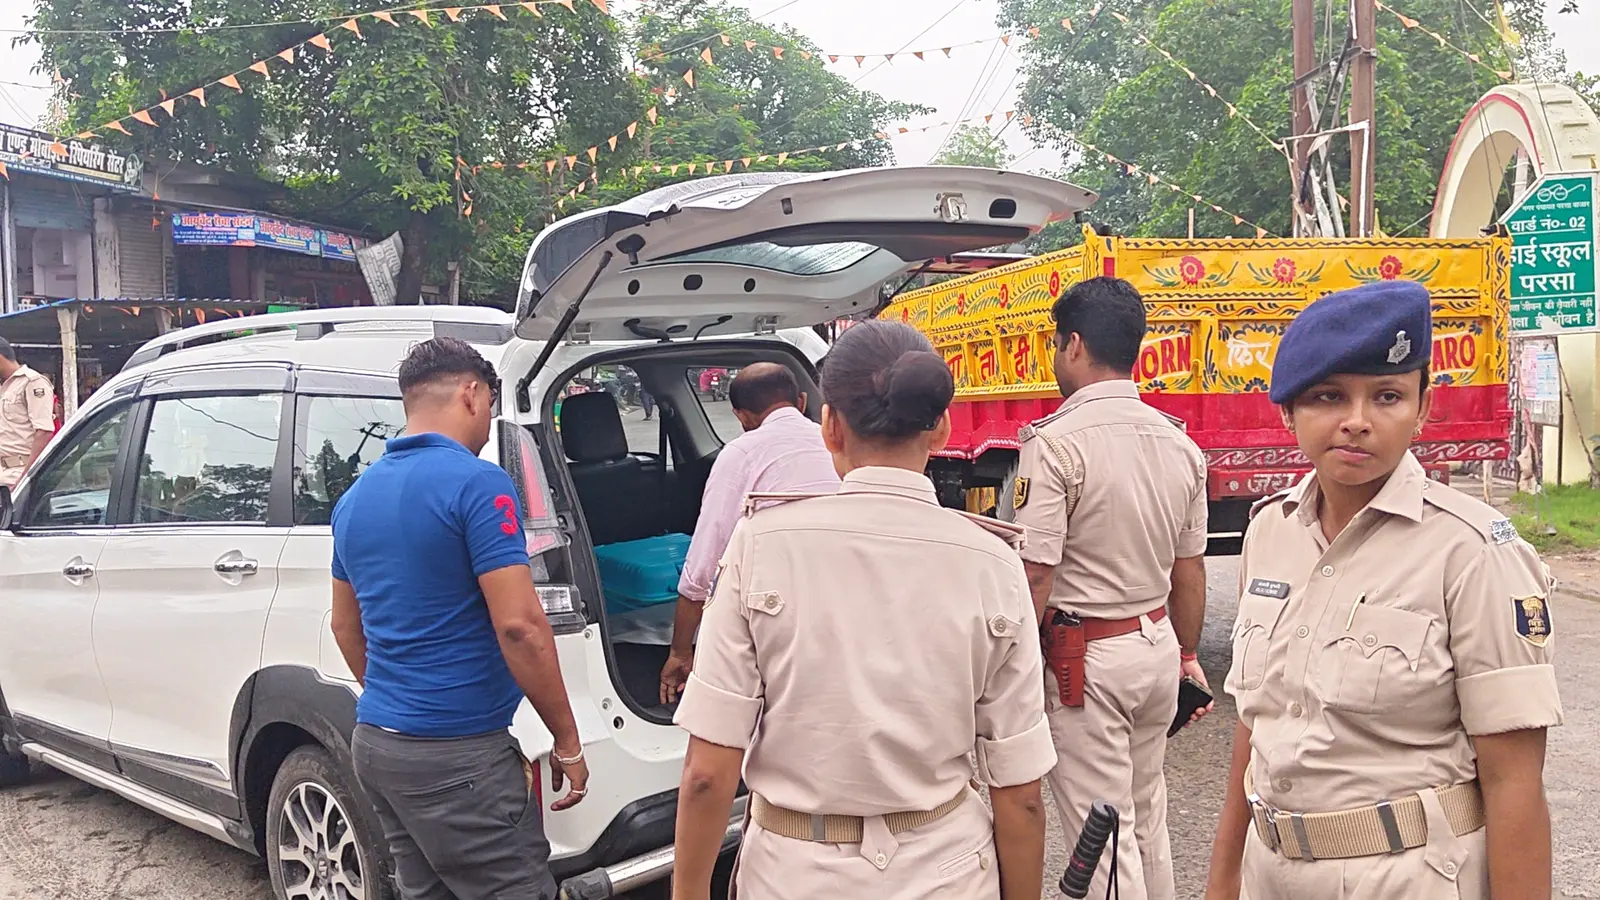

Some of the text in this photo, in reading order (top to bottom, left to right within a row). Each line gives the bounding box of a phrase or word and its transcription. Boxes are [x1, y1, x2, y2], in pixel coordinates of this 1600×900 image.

[7, 132, 28, 154] एण्ड
[69, 140, 106, 171] रिपेयरिंग
[107, 149, 126, 174] सेंटर
[1510, 215, 1537, 232] वार्ड
[1569, 215, 1586, 228] 02
[1539, 239, 1592, 268] स्कूल
[1519, 272, 1576, 293] परसा
[1227, 338, 1273, 371] फिर
[1432, 334, 1476, 373] ARO
[1247, 472, 1298, 494] जय
[493, 494, 519, 536] 3
